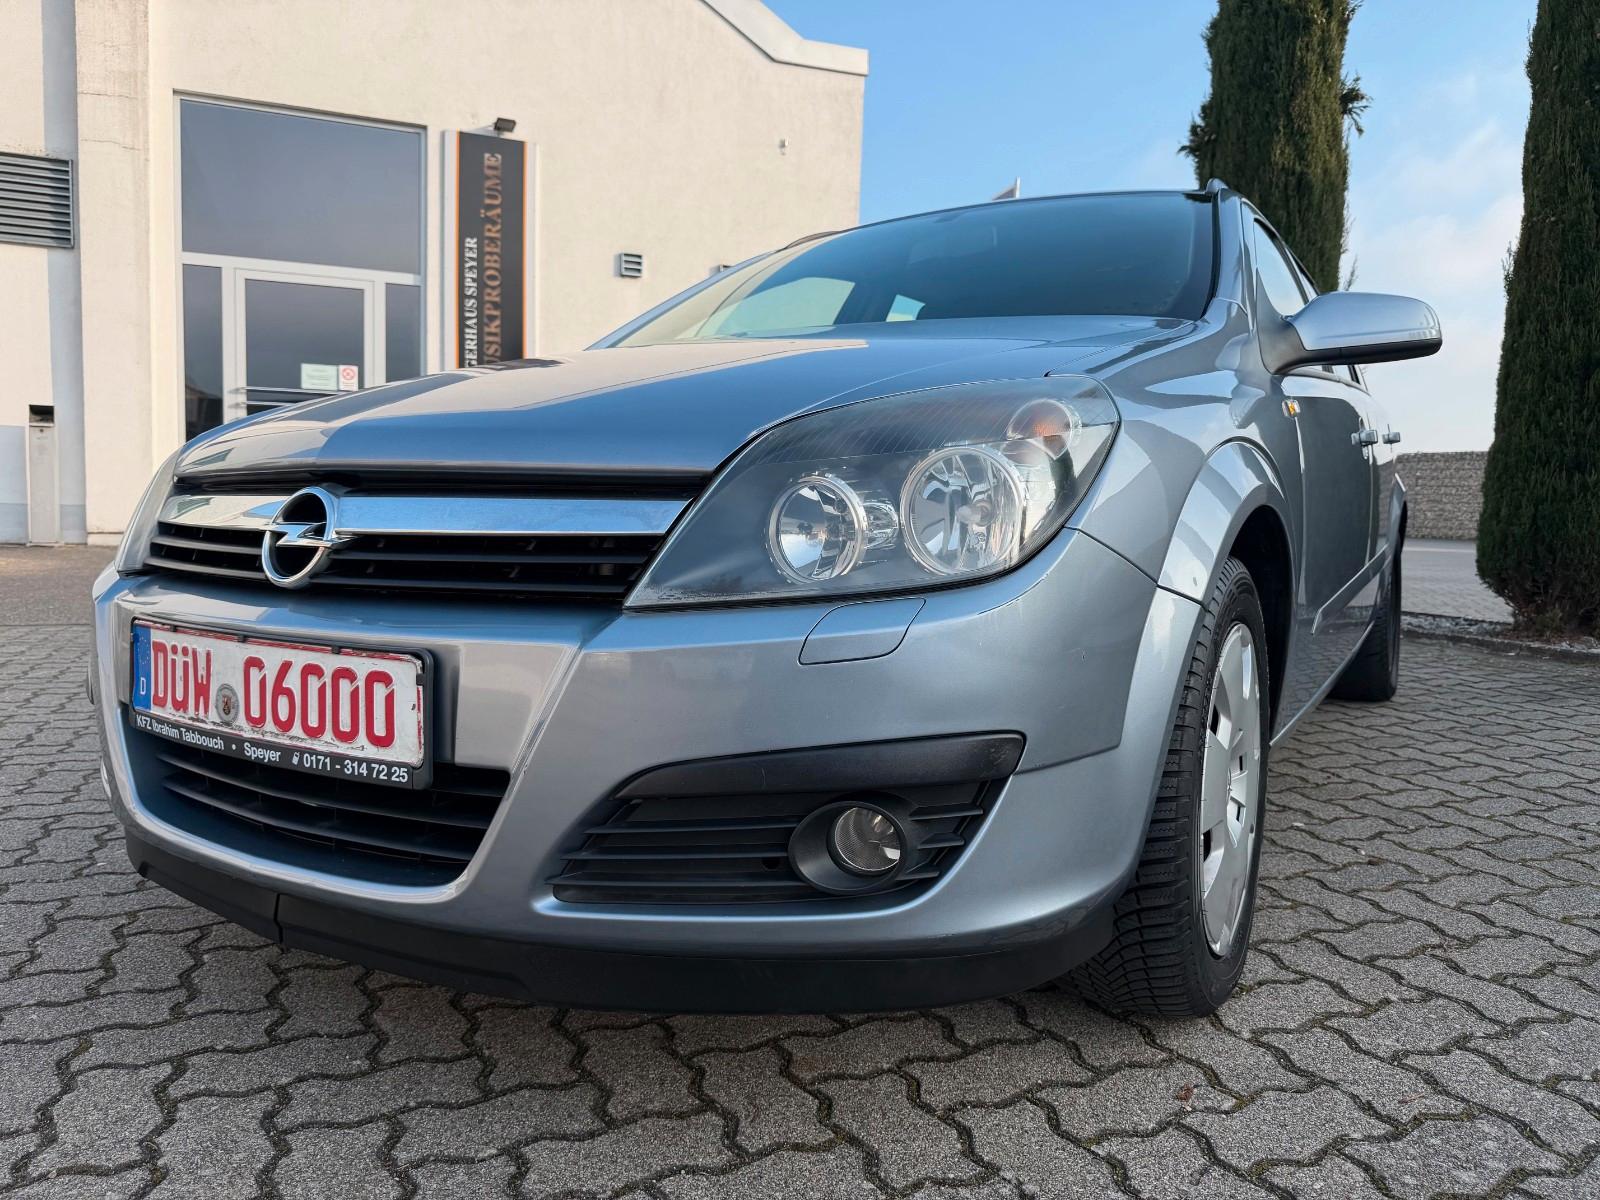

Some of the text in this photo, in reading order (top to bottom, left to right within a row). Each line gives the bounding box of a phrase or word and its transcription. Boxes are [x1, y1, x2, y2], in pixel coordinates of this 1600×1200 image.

[464, 237, 478, 297] SPEYER
[140, 677, 147, 695] D
[151, 639, 212, 720] DÜW
[243, 655, 395, 748] 06000
[136, 714, 282, 763] KFZ Ibrahim Tabbouch Speyer
[302, 753, 331, 771] 0171
[343, 759, 368, 777] 314
[371, 763, 388, 780] 72
[391, 767, 409, 783] 25
